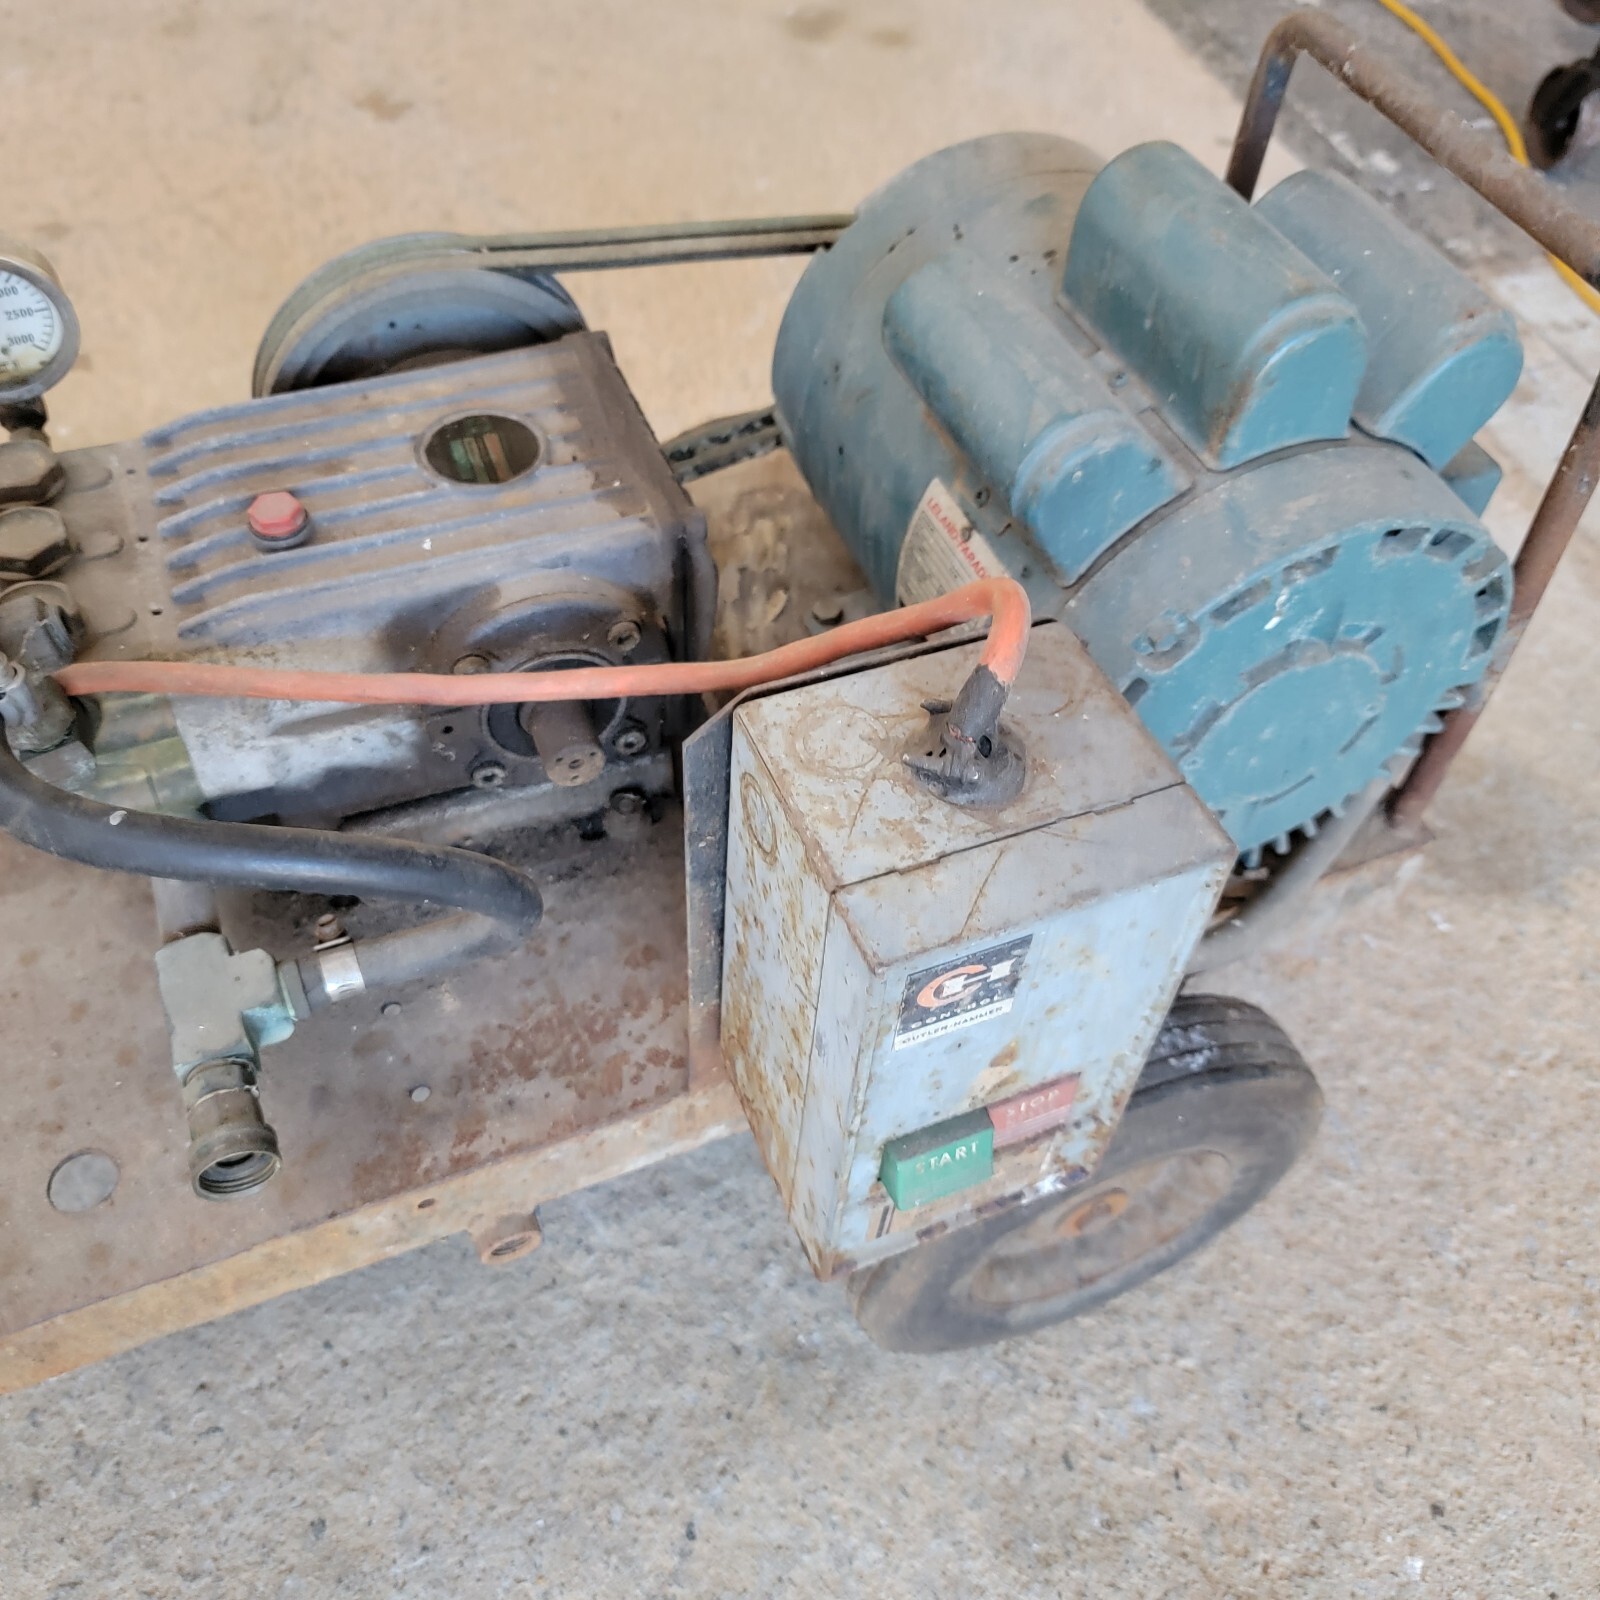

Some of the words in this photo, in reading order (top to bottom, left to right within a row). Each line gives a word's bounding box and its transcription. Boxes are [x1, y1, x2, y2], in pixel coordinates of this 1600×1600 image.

[4, 307, 34, 321] 2500
[7, 333, 35, 347] 3000
[926, 497, 991, 580] LELAND-FARAD
[901, 1006, 1003, 1044] CUTLER-HAMMER
[915, 1141, 979, 1175] START
